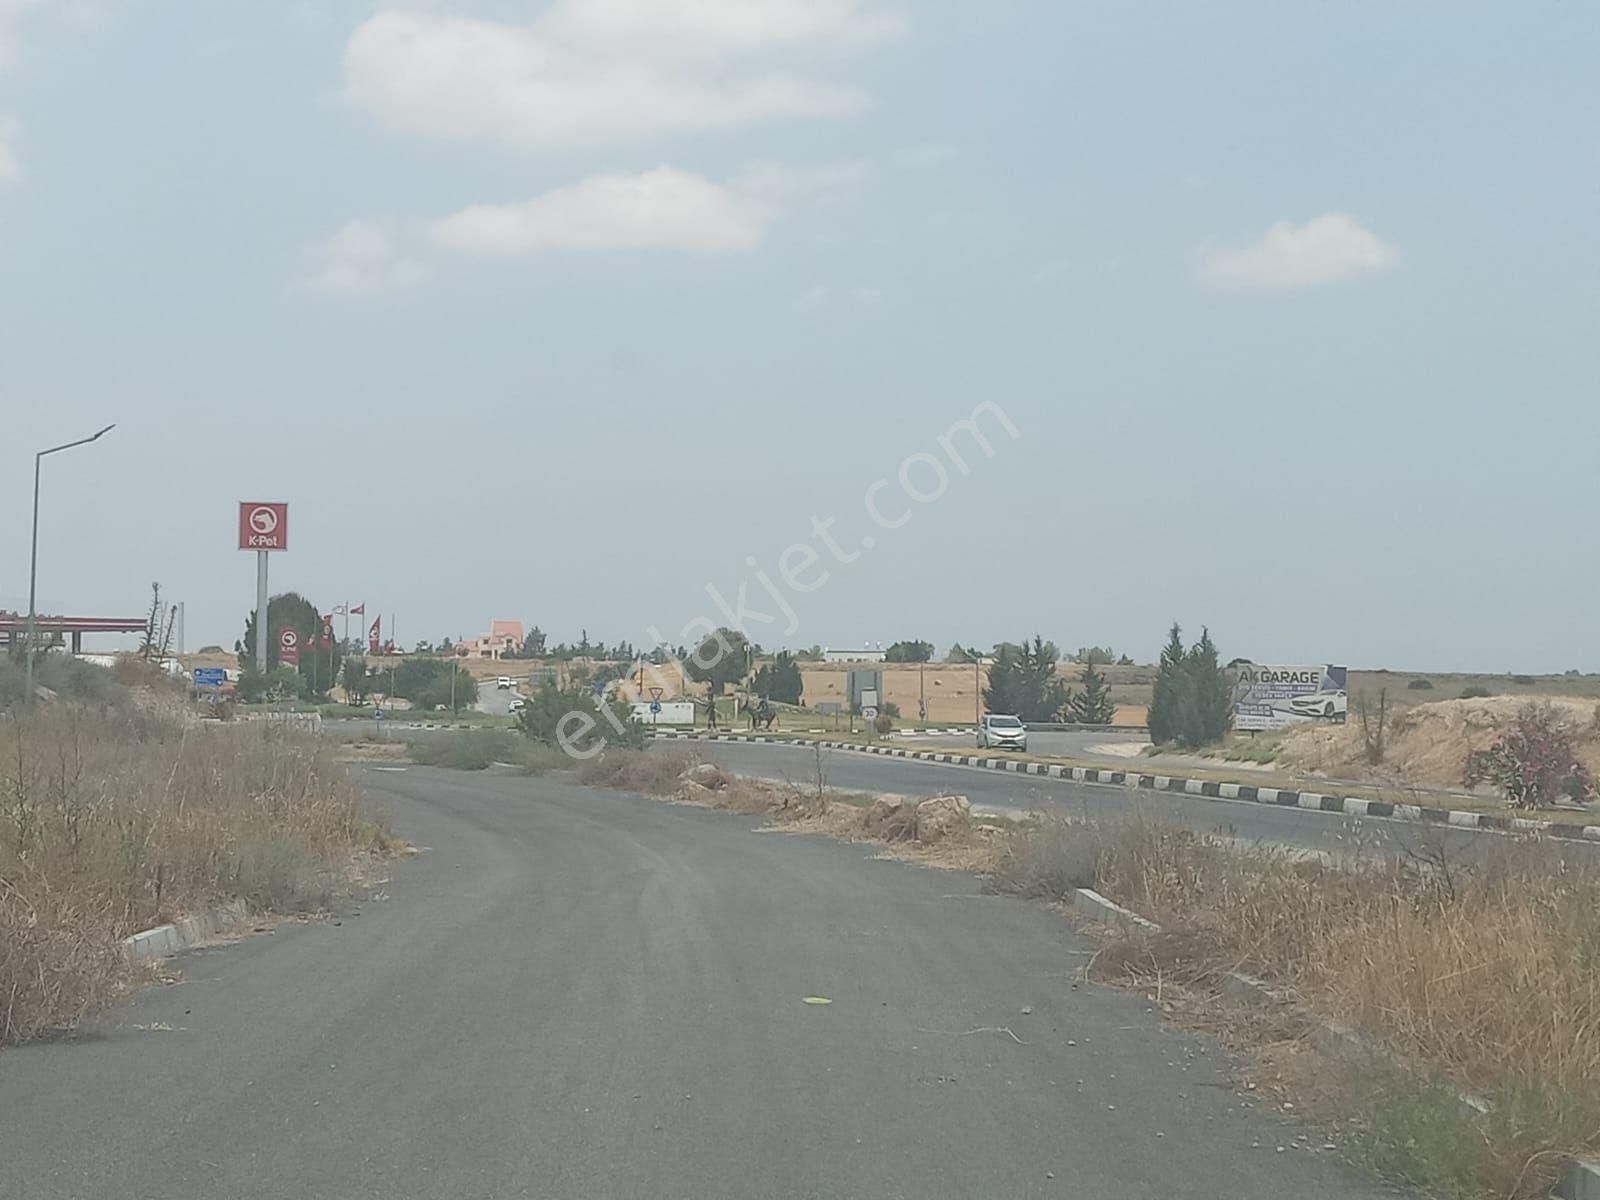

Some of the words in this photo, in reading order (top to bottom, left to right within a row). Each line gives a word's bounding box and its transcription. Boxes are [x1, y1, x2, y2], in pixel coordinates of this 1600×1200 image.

[249, 535, 278, 546] K-Pet
[1239, 671, 1258, 683] AK
[1261, 671, 1319, 683] GARAGE
